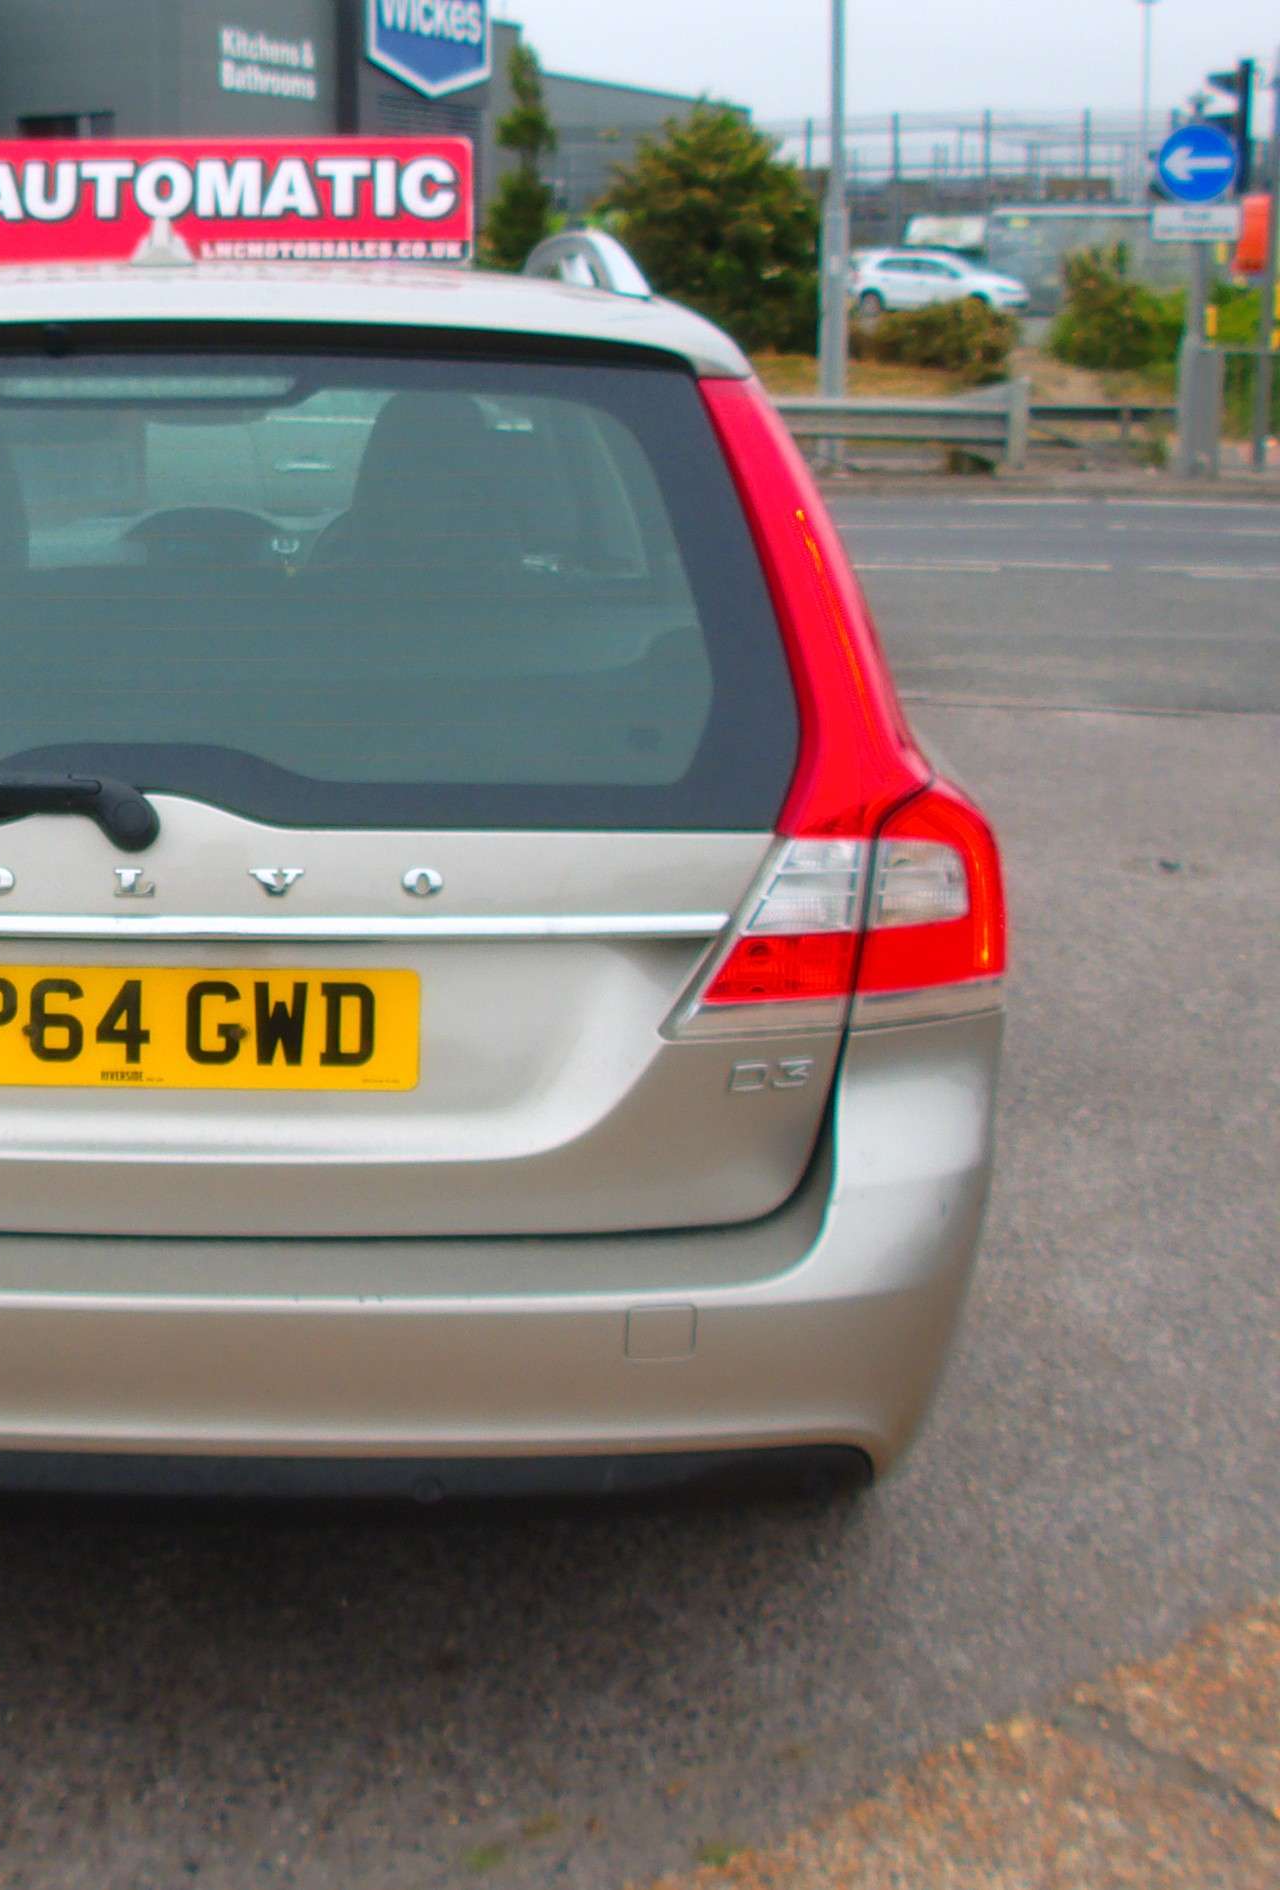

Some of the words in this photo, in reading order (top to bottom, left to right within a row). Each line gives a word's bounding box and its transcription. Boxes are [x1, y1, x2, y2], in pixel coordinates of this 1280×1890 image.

[222, 27, 299, 65] Kitchens
[301, 41, 315, 69] &
[222, 60, 316, 99] Bathrooms
[185, 979, 376, 1068] GWD
[726, 1057, 815, 1091] D3
